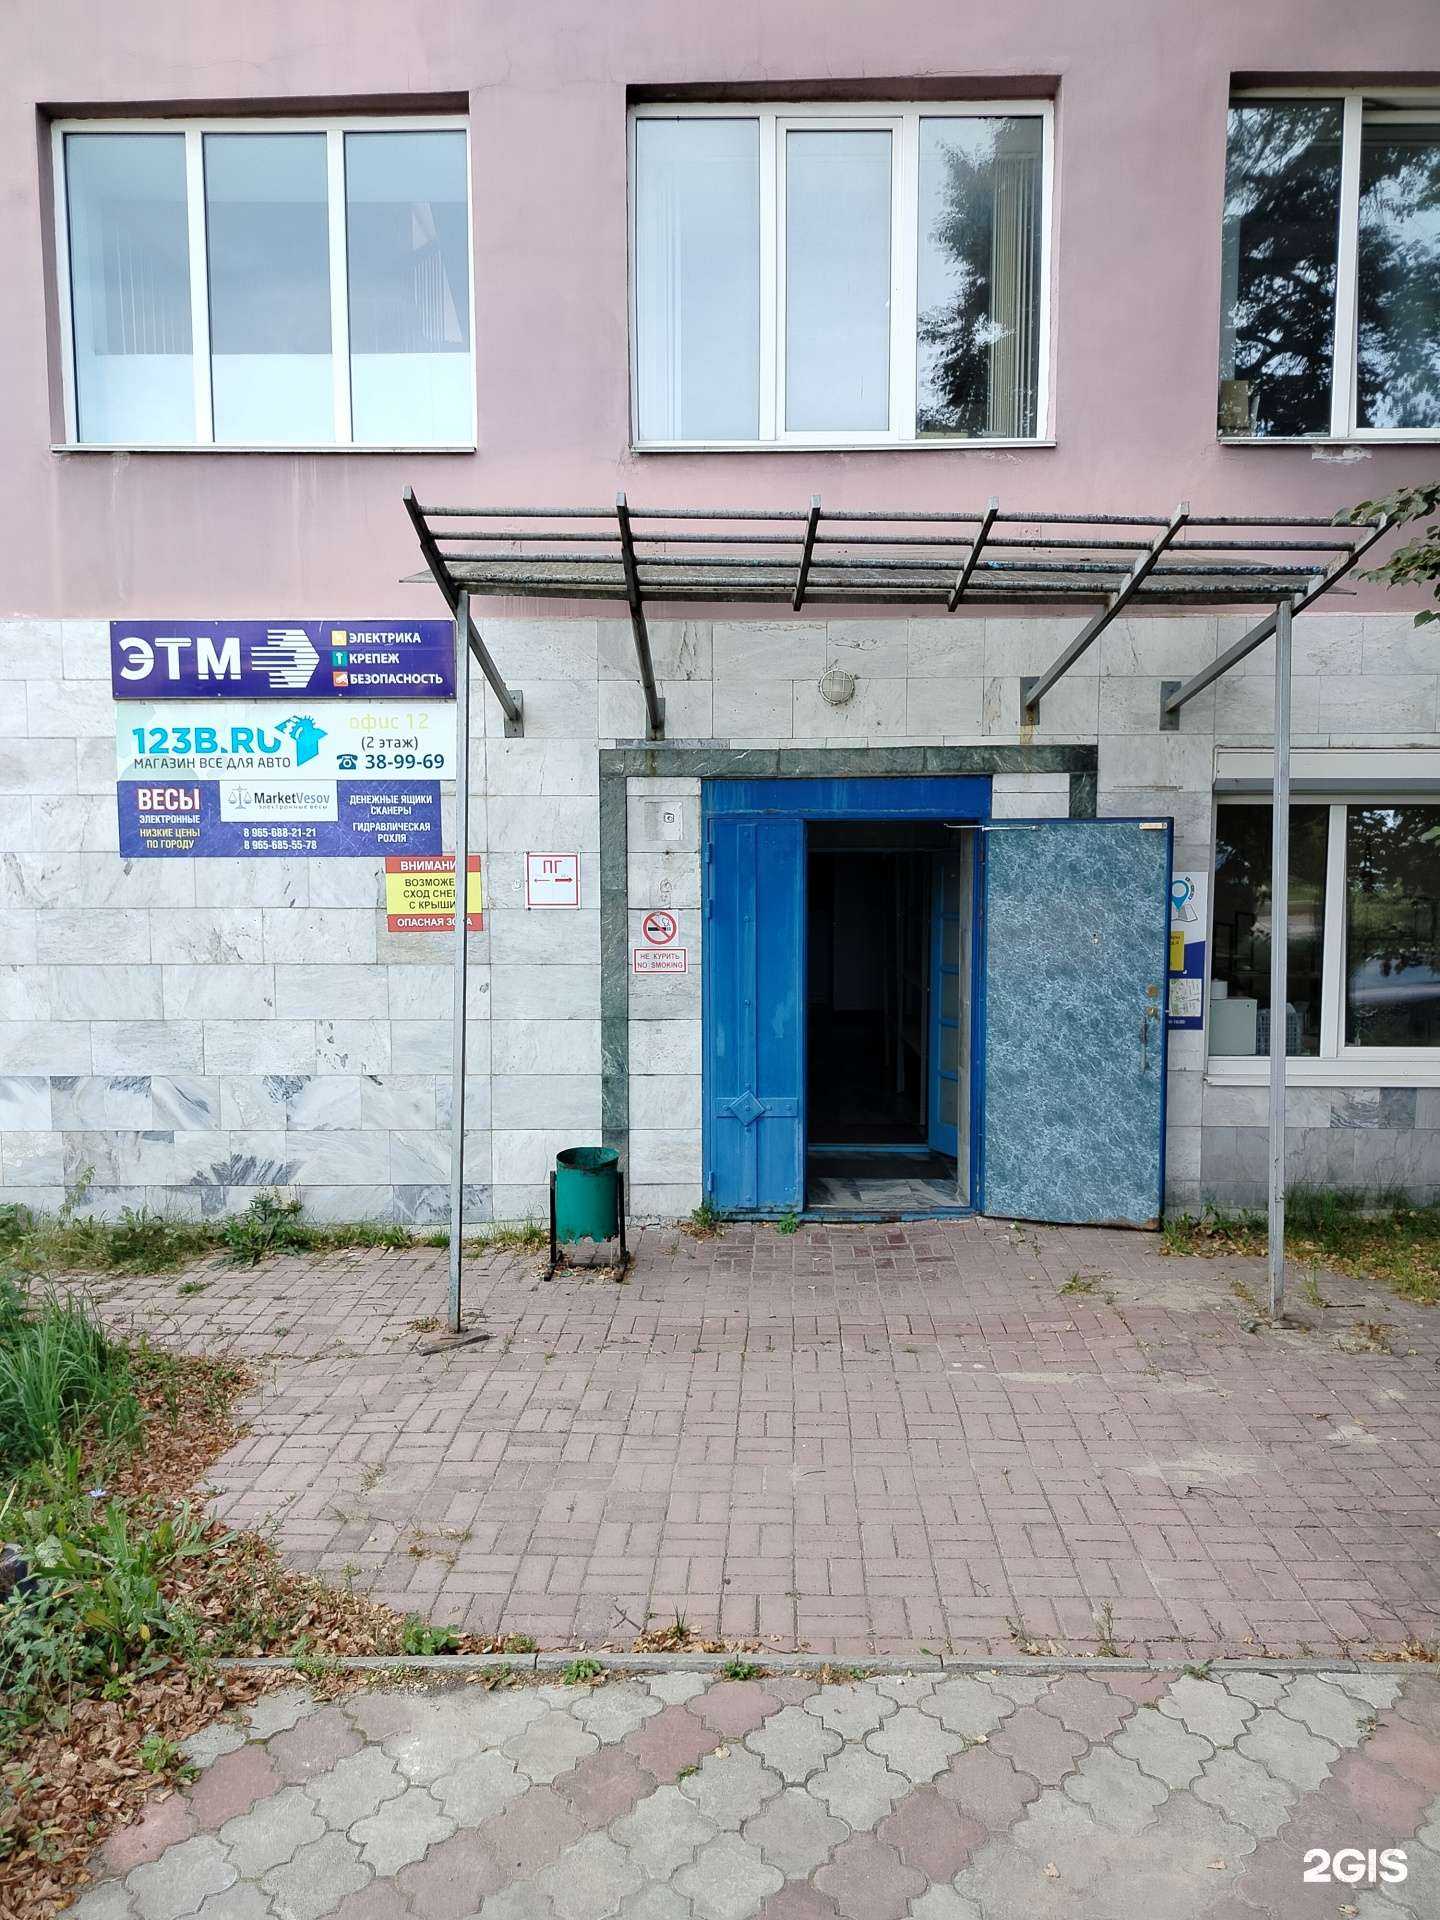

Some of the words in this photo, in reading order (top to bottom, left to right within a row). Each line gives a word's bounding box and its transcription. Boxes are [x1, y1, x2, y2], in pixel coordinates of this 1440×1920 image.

[349, 632, 421, 643] ЭЛЕКТРИКА
[119, 637, 241, 680] ЭТМ
[349, 653, 400, 664] КРЕПЕЖ
[350, 674, 443, 684] БЕЗОПАСНОСТЬ
[349, 714, 399, 732] офис
[406, 713, 429, 729] 12
[361, 736, 374, 750] (2
[379, 736, 419, 750] этаж)
[134, 758, 195, 769] МАГАЗИН
[200, 758, 223, 768] ВСЕ
[227, 757, 253, 770] ДЛЯ
[257, 757, 291, 768] АВТО
[365, 754, 445, 769] 38-99-69
[138, 788, 200, 811] ВЕСЫ
[253, 792, 330, 804] MarketVesov
[350, 795, 399, 805] ДЕНЕЖНЫЕ
[401, 795, 433, 805] ЯЩИКИ
[370, 806, 412, 815] СКАНЕРЫ
[139, 814, 201, 824] ЭЛЕКТРОННЫЕ
[352, 822, 431, 832] ГИДРАВЛИЧЕСКАЯ
[140, 828, 173, 838] НИЗКИЕ
[175, 828, 200, 839] ЦЕНЫ
[243, 828, 249, 838] 8
[377, 833, 407, 843] РОХЛЯ
[146, 840, 158, 849] ПО
[160, 839, 195, 849] ГОРОДУ
[244, 840, 250, 850] 8
[400, 860, 456, 871] ВНИМАНИ
[543, 860, 563, 873] ПГ
[405, 878, 455, 887] ВОЗМОЖЕ
[403, 889, 430, 899] СХОД
[409, 901, 416, 909] С
[397, 917, 444, 927] ОПАСНАЯ
